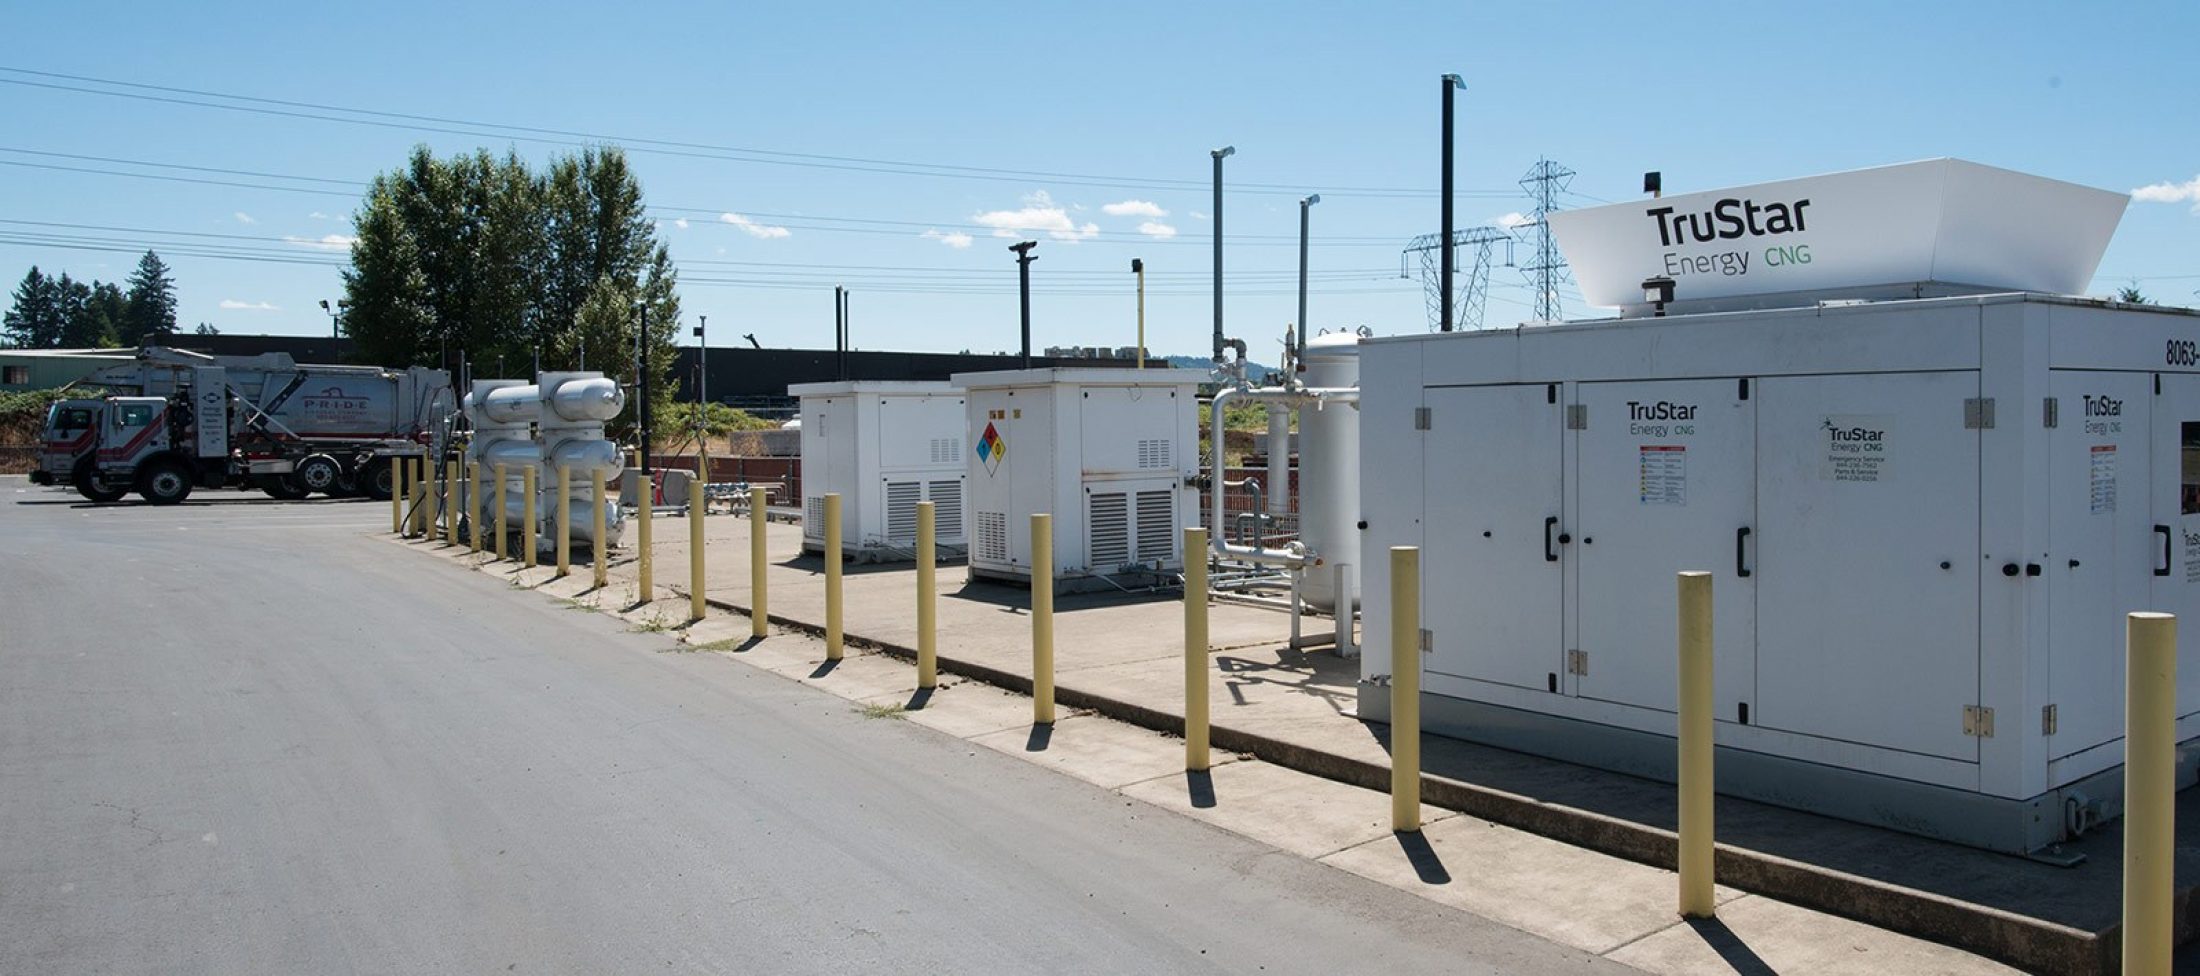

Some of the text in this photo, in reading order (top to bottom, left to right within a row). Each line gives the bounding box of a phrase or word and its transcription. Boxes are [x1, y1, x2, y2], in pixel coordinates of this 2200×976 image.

[1646, 198, 1811, 246] TruStar
[1664, 245, 1812, 276] Energy CNG
[1627, 401, 1698, 420] TruStar
[2082, 395, 2123, 417] TruStar
[1630, 423, 1695, 437] Energy CNG
[1829, 427, 1884, 441] TruStar
[2085, 420, 2108, 436] Energy
[1831, 443, 1883, 453] Energy CNG
[1828, 455, 1862, 463] Emergency
